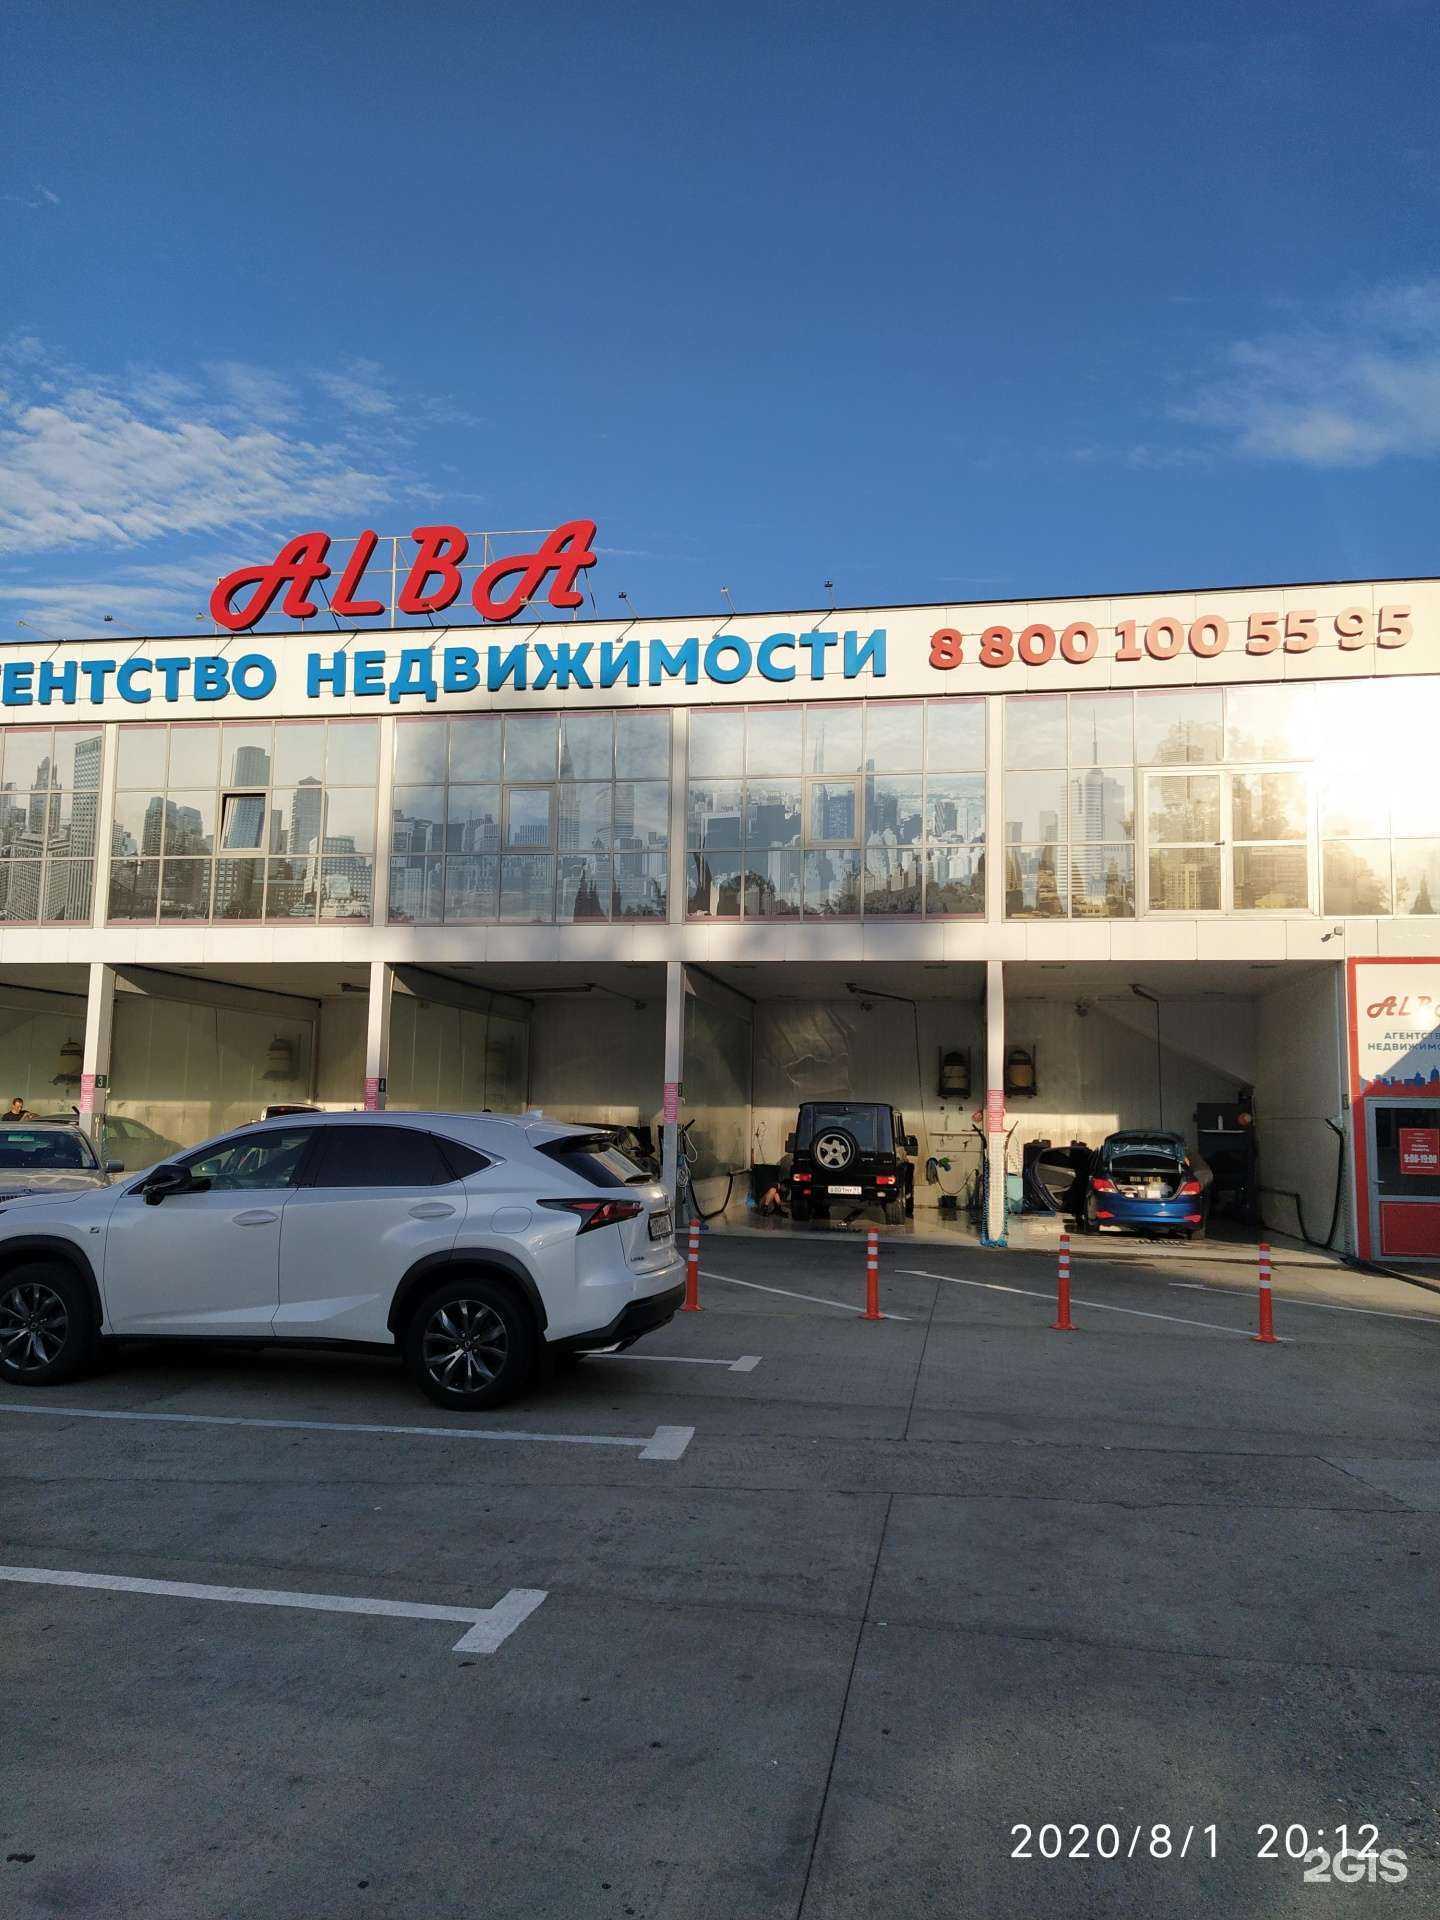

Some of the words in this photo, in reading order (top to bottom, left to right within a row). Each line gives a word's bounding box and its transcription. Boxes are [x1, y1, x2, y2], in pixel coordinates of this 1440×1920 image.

[209, 518, 598, 632] ALBA
[0, 652, 278, 706] ЕНТСТВО
[306, 628, 887, 704] НЕДВИЖИМОСТИ
[929, 627, 964, 670] 8
[979, 621, 1099, 668] 800
[1114, 614, 1230, 661] 100
[1246, 611, 1319, 655] 55
[1334, 604, 1414, 651] 95
[97, 1076, 104, 1087] 3
